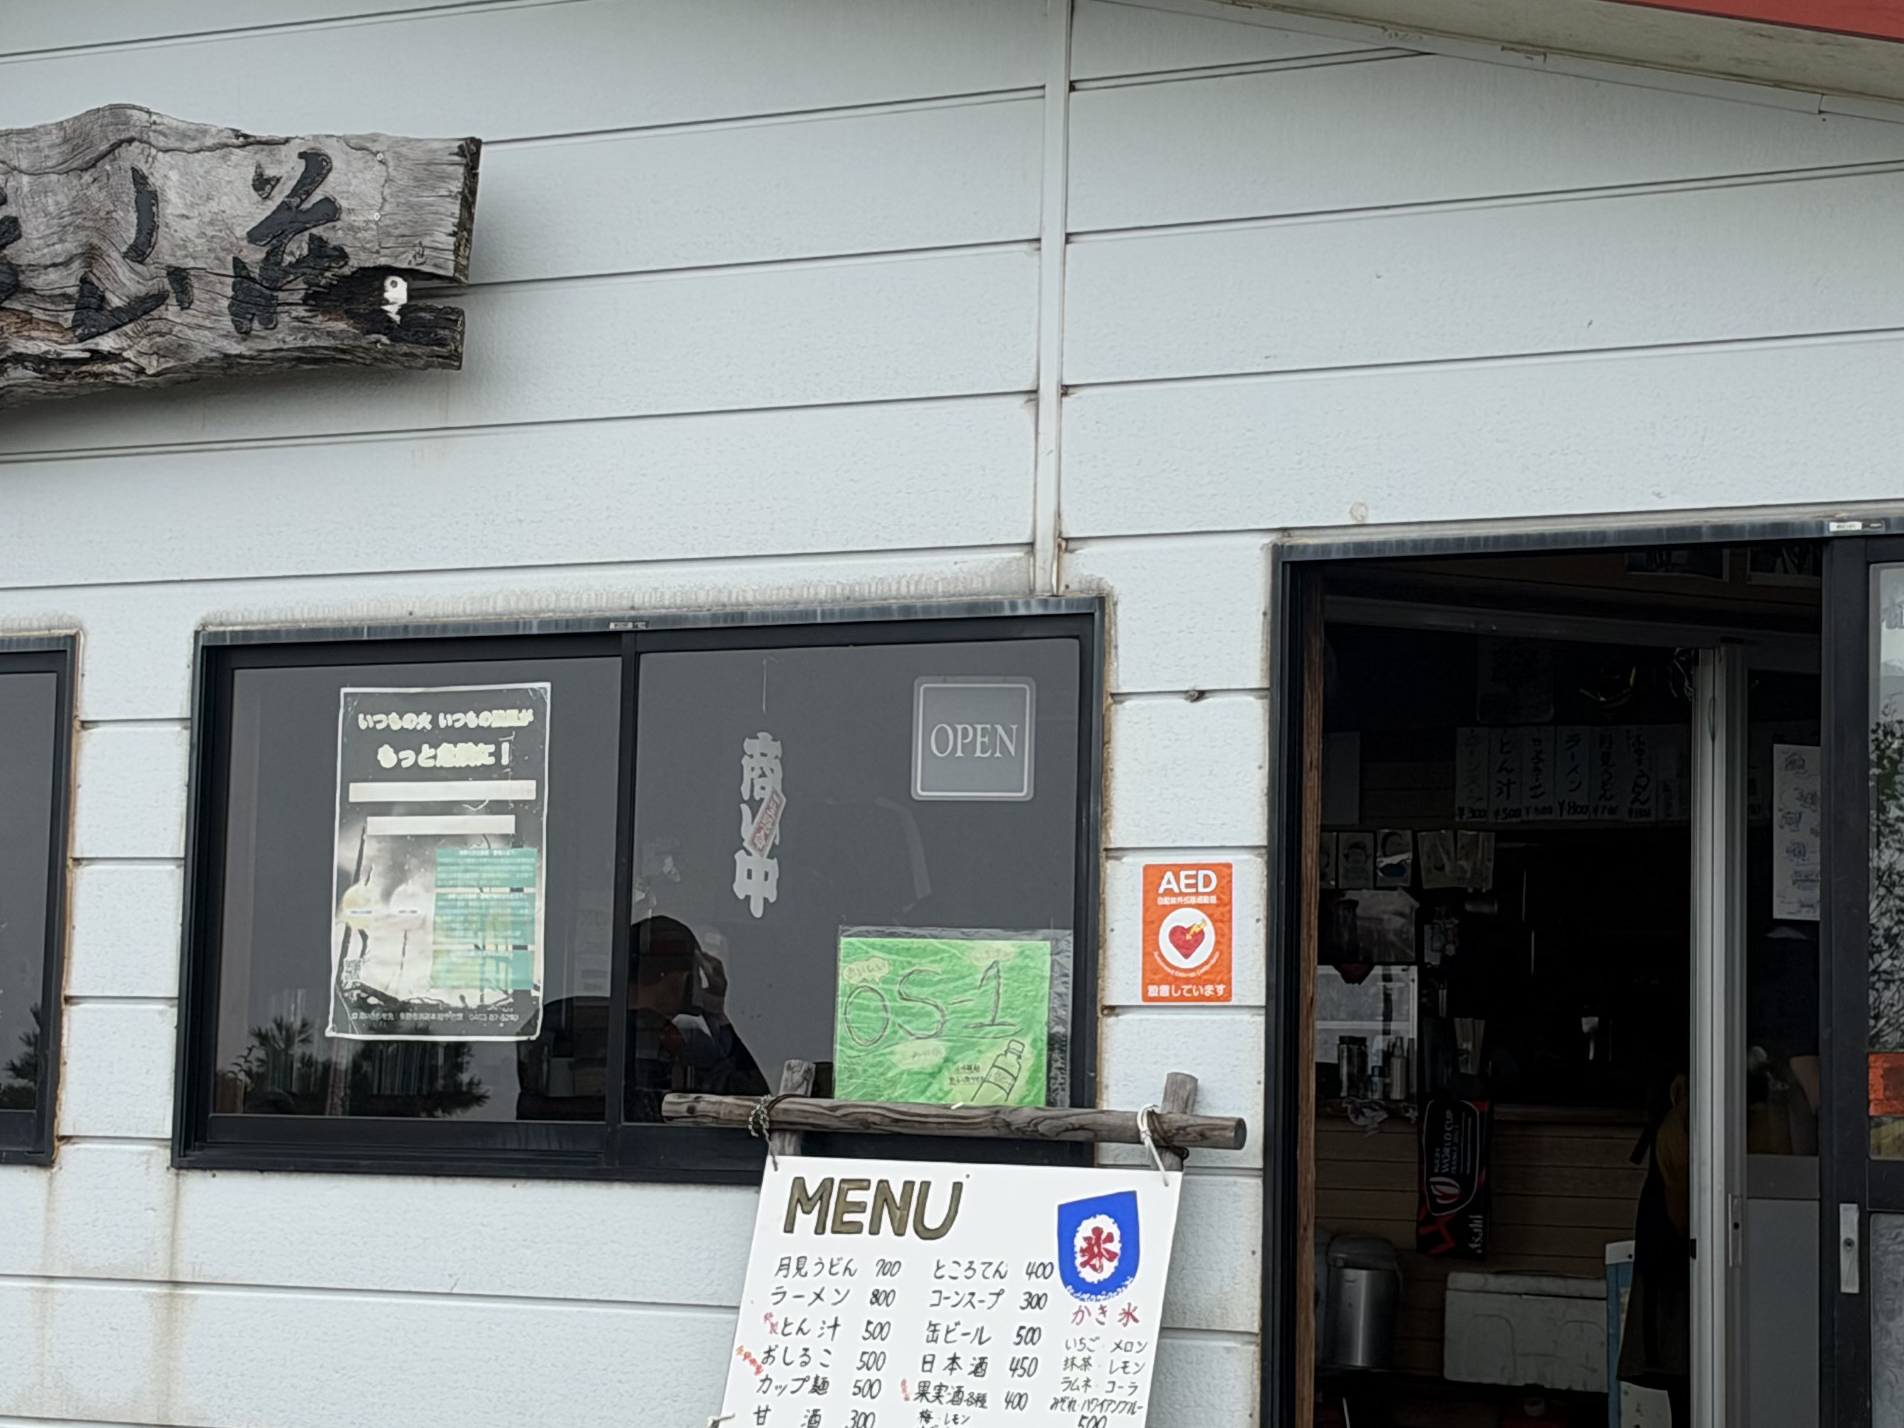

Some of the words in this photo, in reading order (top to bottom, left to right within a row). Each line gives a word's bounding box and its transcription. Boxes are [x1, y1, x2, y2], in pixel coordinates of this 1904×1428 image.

[930, 723, 1018, 757] OPEN
[1496, 735, 1517, 800] とん汁
[1566, 732, 1583, 793] ラーメン
[1157, 869, 1218, 894] AED
[844, 959, 1017, 1047] OS-1
[1147, 983, 1226, 997] 設置しています
[783, 1176, 963, 1241] MENU
[774, 1255, 859, 1279] 月見うどん
[874, 1258, 902, 1278] 700
[932, 1258, 1008, 1280] ところてん
[1025, 1261, 1055, 1281] 400
[770, 1286, 851, 1307] ラーメン
[869, 1288, 897, 1308] 800
[928, 1288, 1006, 1310] コーンスープ
[1019, 1291, 1049, 1311] 300
[1071, 1302, 1140, 1328] かき氷
[780, 1316, 842, 1341] とん汁
[861, 1319, 892, 1341] 500
[925, 1319, 992, 1346] 缶ビール
[1013, 1325, 1042, 1346] 500
[761, 1344, 833, 1368] おしるこ
[856, 1350, 887, 1372] 500
[921, 1351, 989, 1378] 日本酒
[1008, 1356, 1039, 1378] 450
[756, 1374, 831, 1397] カップ麺
[851, 1378, 882, 1400] 500
[1003, 1390, 1029, 1411] 400
